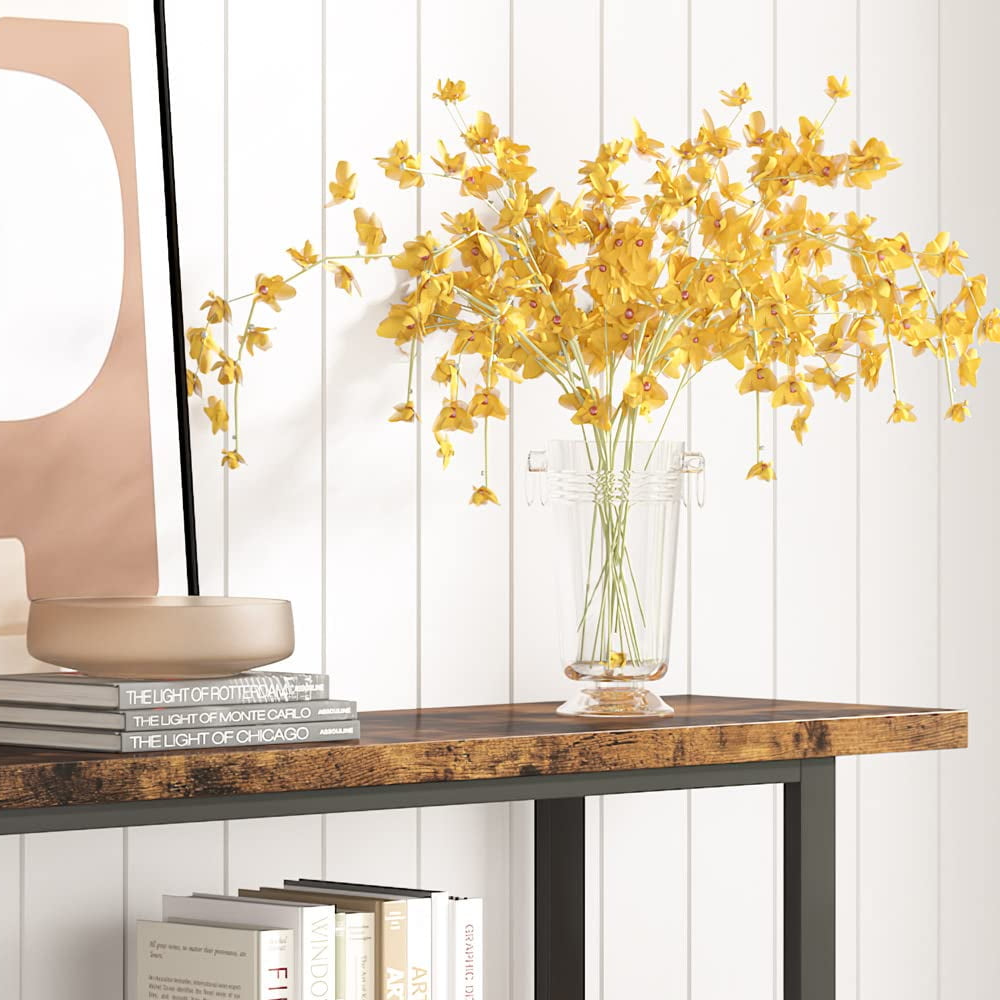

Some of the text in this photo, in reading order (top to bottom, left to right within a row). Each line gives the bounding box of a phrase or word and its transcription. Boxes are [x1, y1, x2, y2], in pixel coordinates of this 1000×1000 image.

[126, 684, 288, 704] THE LIGHT OF ROTTERDAM
[133, 707, 311, 727] THE LIGHT OF MONTE CARLO
[129, 726, 309, 749] THE LIGHT OF CHICAGO
[464, 924, 474, 981] GRAPHIC
